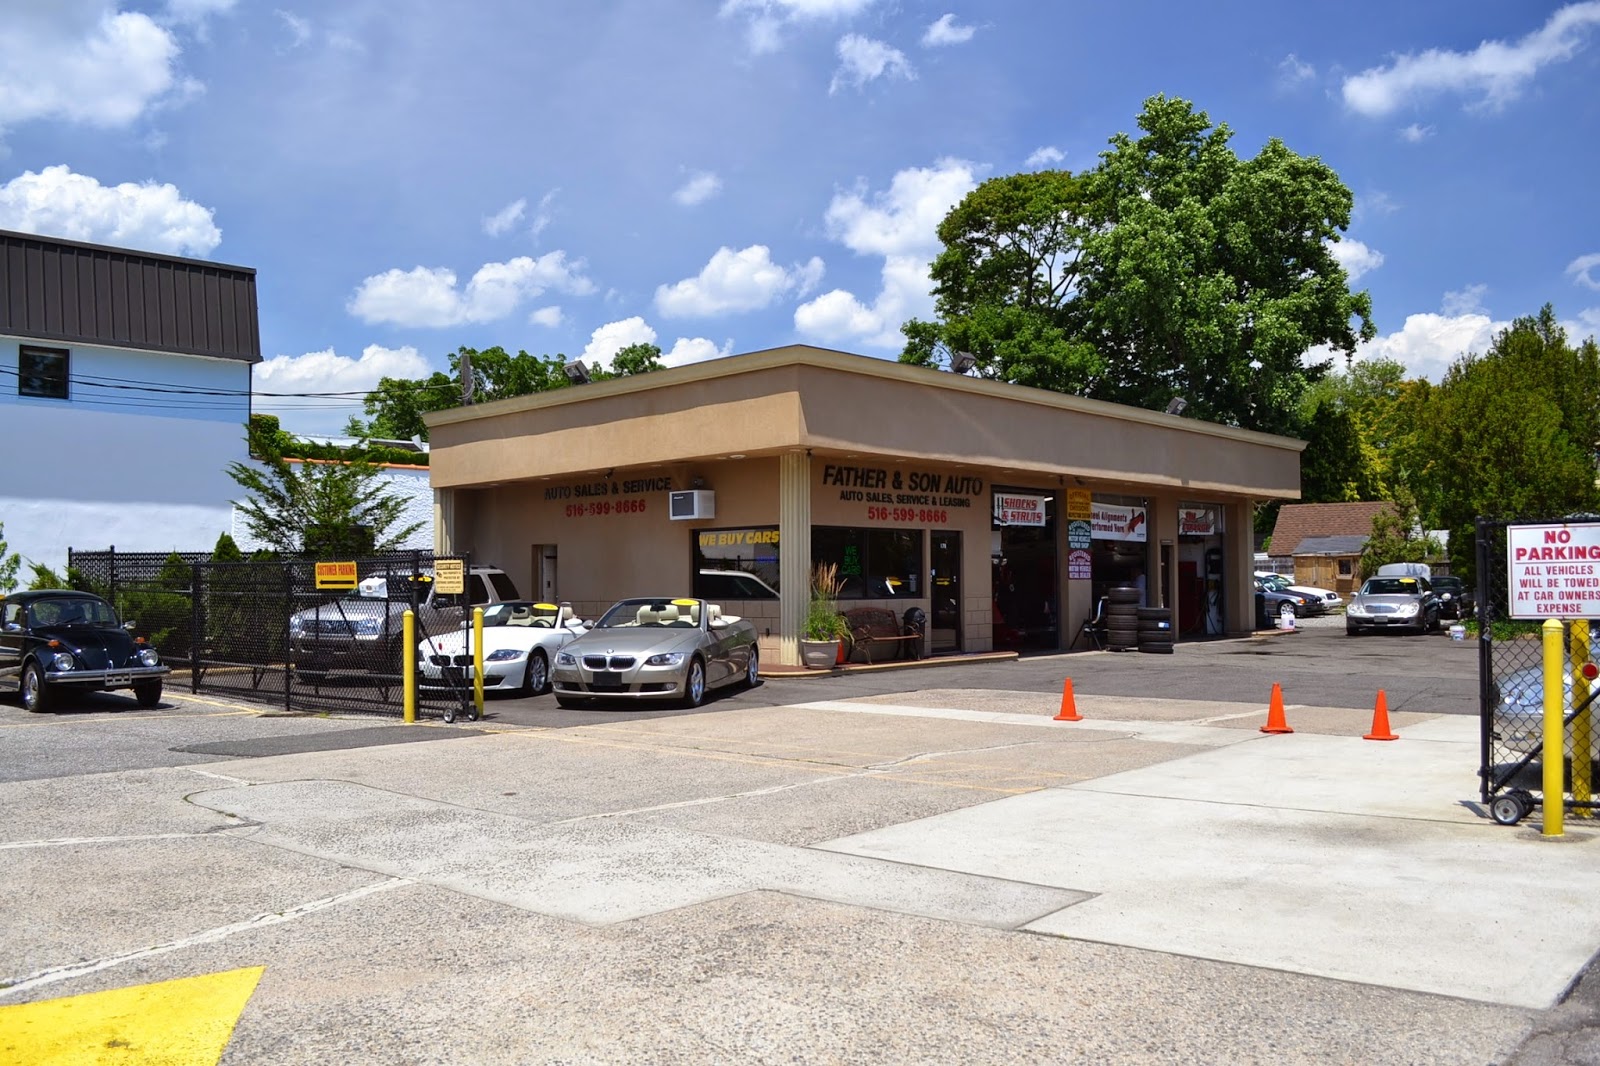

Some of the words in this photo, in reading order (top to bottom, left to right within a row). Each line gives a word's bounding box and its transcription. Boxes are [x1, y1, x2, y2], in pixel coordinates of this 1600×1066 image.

[823, 464, 887, 489] FATHER
[891, 470, 903, 490] &
[908, 472, 941, 493] SON
[944, 474, 983, 496] AUTO
[544, 486, 571, 500] AUTO
[574, 483, 608, 497] SALES
[611, 482, 619, 495] &
[623, 477, 672, 493] SERVICE
[840, 490, 864, 501] AUTO
[896, 494, 930, 505] SERVICE
[931, 496, 938, 506] &
[939, 497, 971, 508] LEASING
[1004, 497, 1038, 510] SHOCKS
[868, 506, 947, 523] 516-599-8666
[1001, 510, 1009, 521] &
[1010, 511, 1043, 523] STRUTS
[1101, 511, 1127, 523] Alignments
[1091, 522, 1113, 532] erformed
[698, 534, 716, 546] WE
[718, 532, 745, 545] BUY
[745, 530, 780, 545] CARS
[1544, 530, 1571, 544] NO
[1515, 545, 1600, 561] PARKING
[337, 564, 355, 576] PARKING
[1524, 566, 1542, 576] ALL
[1545, 565, 1594, 575] VEHICLES
[1519, 578, 1543, 588] WILL
[1547, 578, 1559, 588] BE
[1563, 578, 1599, 588] TOWED
[1517, 591, 1530, 601] AT
[1533, 591, 1554, 600] CAR
[1558, 590, 1600, 600] OWNERS
[1536, 603, 1582, 613] EXPENSE
